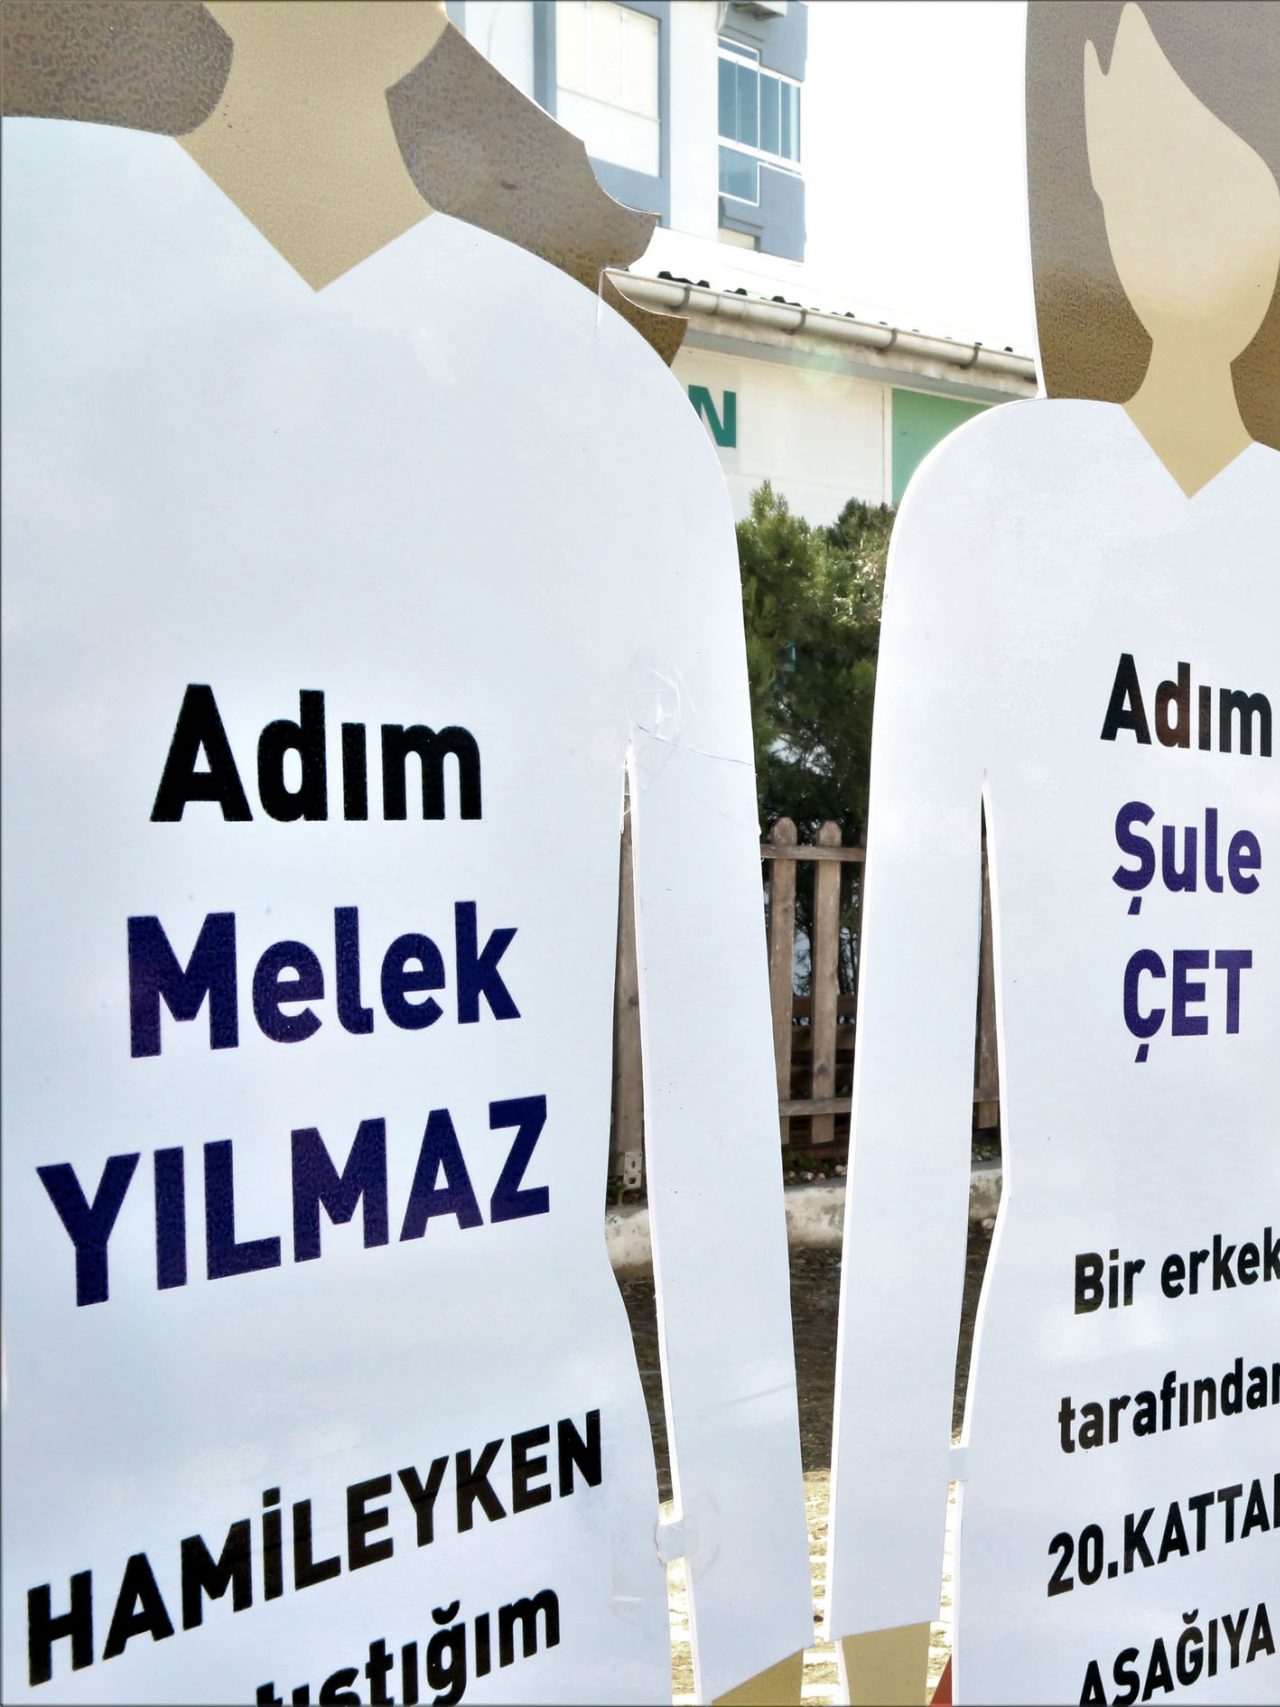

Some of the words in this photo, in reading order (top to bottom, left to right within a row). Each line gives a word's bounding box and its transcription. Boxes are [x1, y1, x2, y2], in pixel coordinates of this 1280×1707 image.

[151, 683, 481, 821] Adım
[1101, 653, 1272, 757] Adım
[1112, 801, 1262, 915] Şule
[127, 902, 521, 1058] Melek
[1123, 949, 1252, 1063] ÇET
[37, 1095, 550, 1306] YILMAZ
[1075, 1248, 1145, 1315] Bir
[28, 1409, 602, 1686] HAMİLEYKEN
